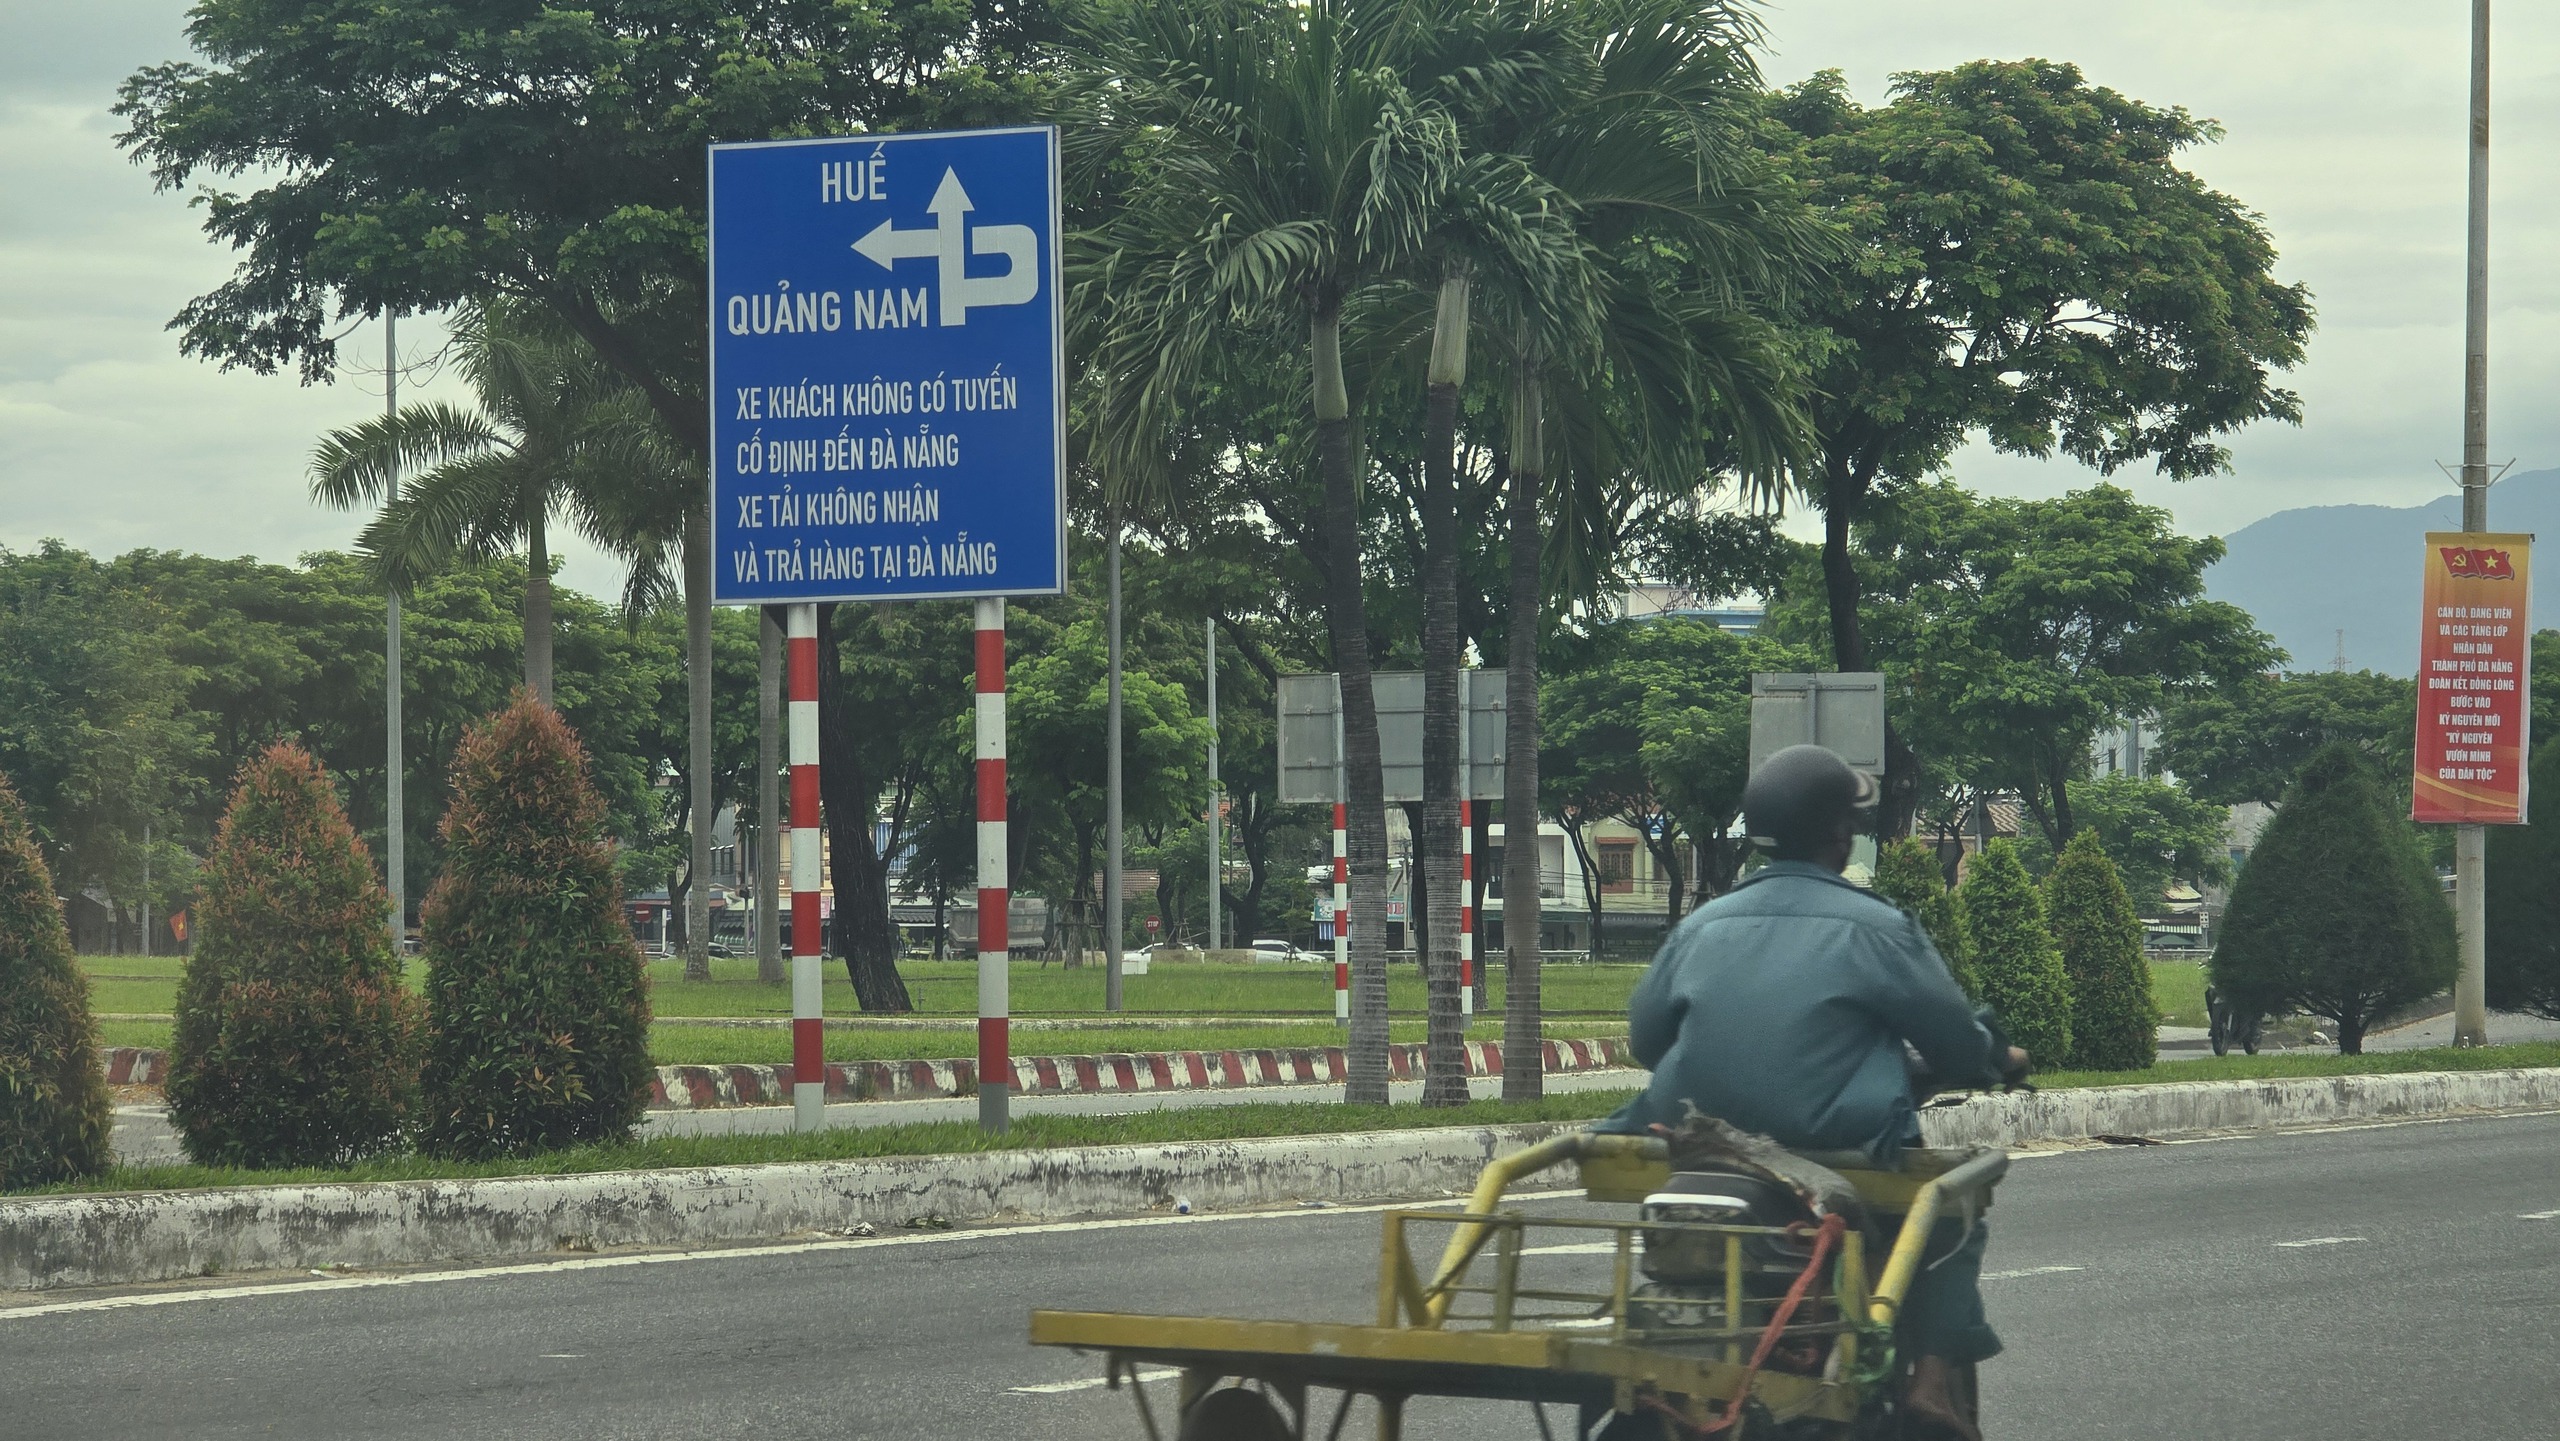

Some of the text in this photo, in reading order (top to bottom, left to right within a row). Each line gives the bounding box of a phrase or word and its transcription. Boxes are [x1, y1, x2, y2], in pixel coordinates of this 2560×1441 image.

[821, 141, 887, 203] HUẾ
[728, 279, 928, 336] QUẢNG NAM
[736, 362, 1017, 420] XE KHÁCH KHÔNG CÓ TUYẾN
[736, 423, 959, 478] CỐ ĐỊNH ĐẾN ĐÀ NẴNG
[737, 482, 939, 528] XE TẢI KHÔNG NHẬN
[733, 531, 997, 583] VÀ TRẢ HÀNG TẠI ĐÀ NẴNG
[1147, 920, 1159, 928] STOP
